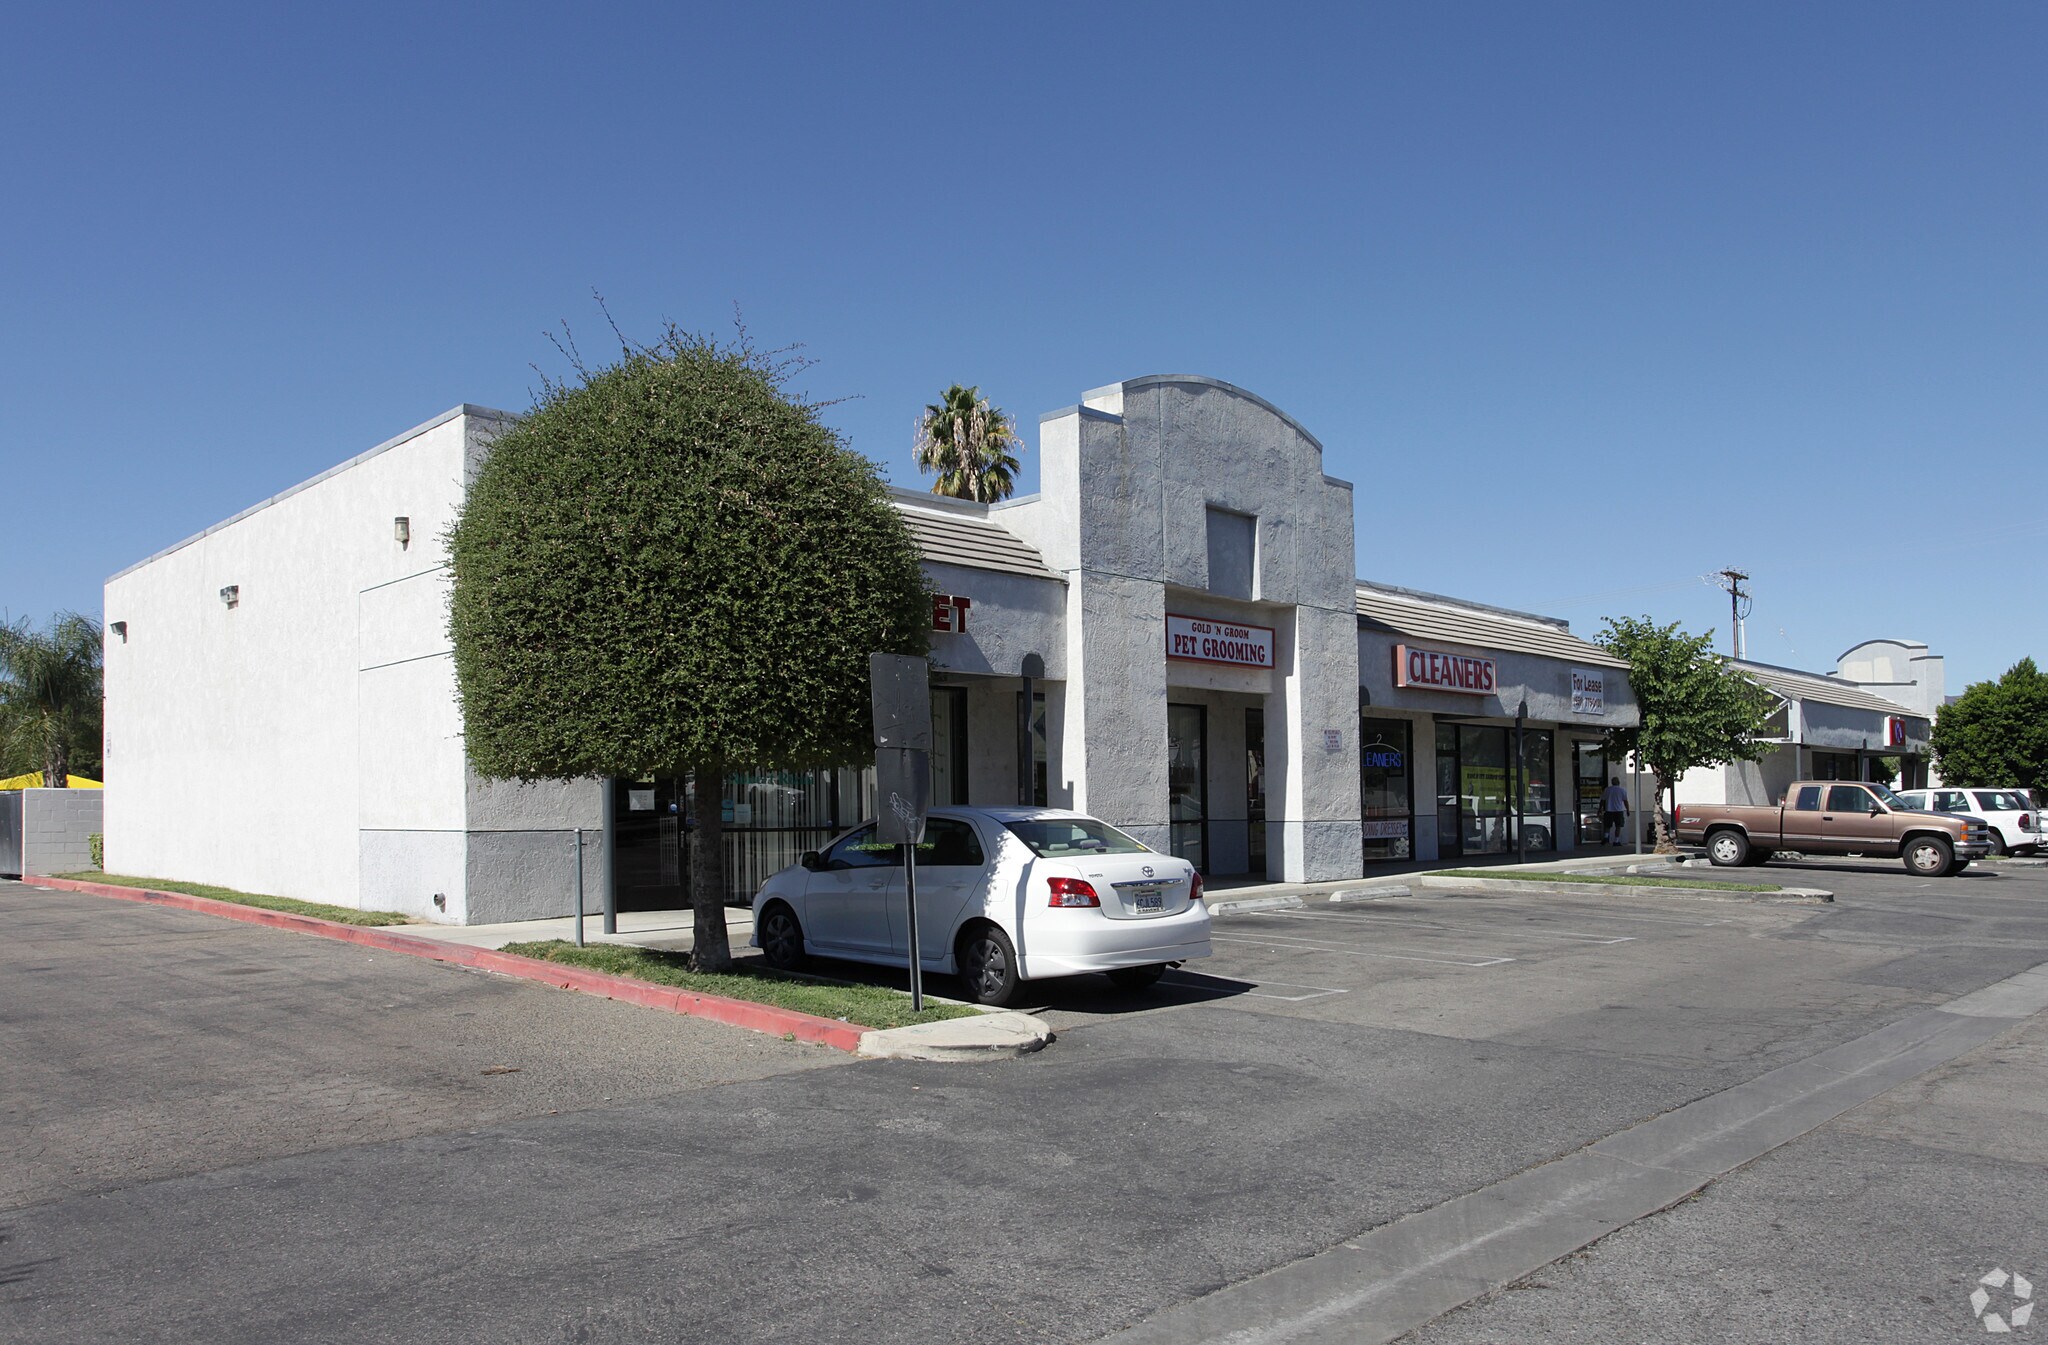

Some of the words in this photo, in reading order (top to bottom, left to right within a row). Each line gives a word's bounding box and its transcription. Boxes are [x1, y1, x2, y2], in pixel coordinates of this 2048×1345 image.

[1192, 622, 1211, 634] GOLD
[1224, 627, 1249, 639] GROOM
[1174, 634, 1197, 655] PET
[1202, 637, 1265, 663] GROOMING
[1409, 651, 1493, 691] CLEANERS
[1572, 673, 1583, 691] For
[1583, 675, 1602, 693] Lease
